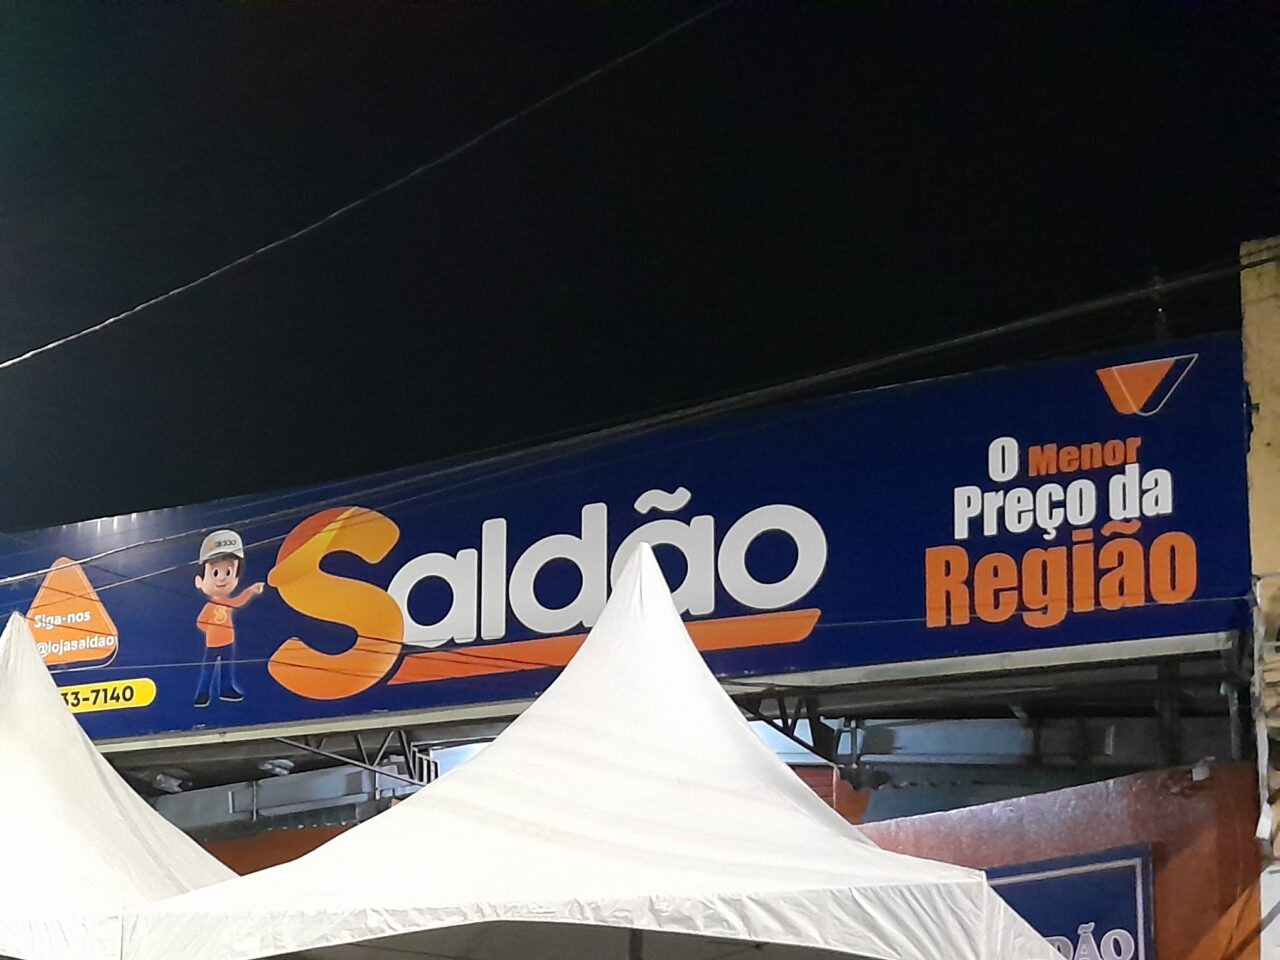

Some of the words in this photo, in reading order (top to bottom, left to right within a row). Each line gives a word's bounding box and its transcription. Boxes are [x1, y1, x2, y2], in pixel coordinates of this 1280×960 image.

[988, 436, 1018, 482] O
[1027, 436, 1142, 477] Menor
[954, 485, 1097, 540] Preço
[1108, 463, 1173, 521] da
[267, 487, 828, 701] Saldão
[925, 518, 1197, 628] Região
[34, 610, 91, 630] Siga-nos
[35, 635, 115, 657] @lojasaldao
